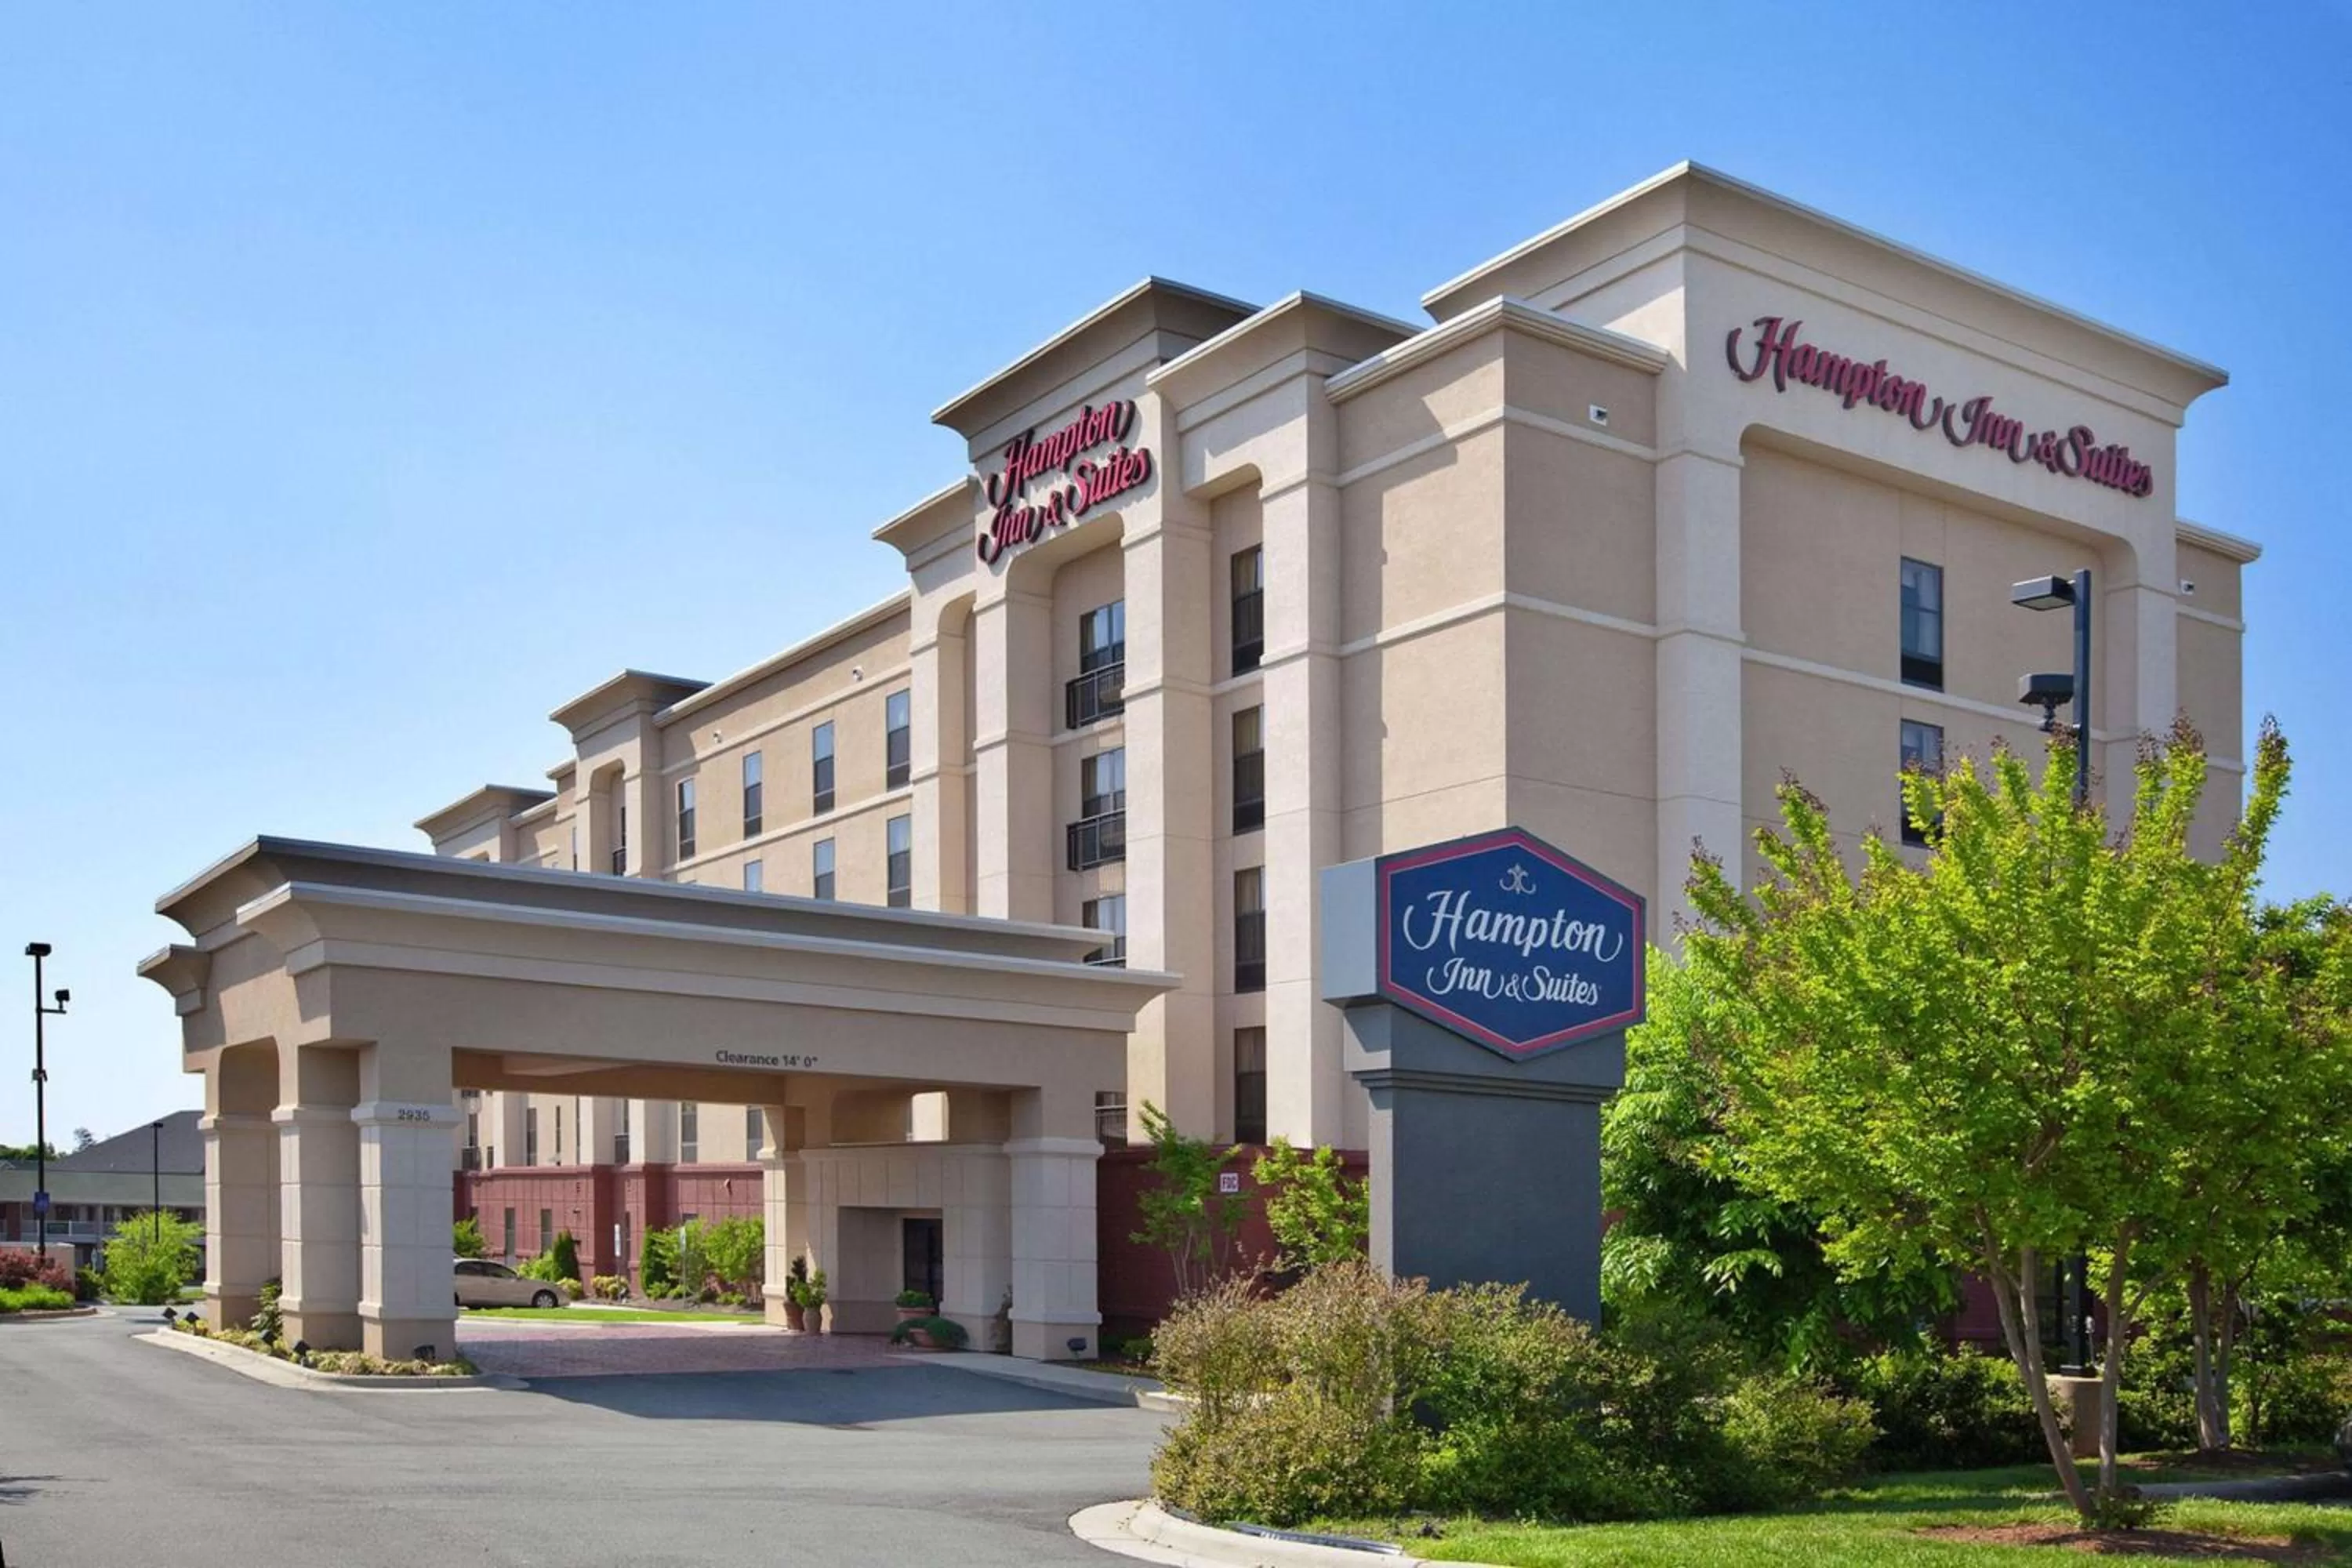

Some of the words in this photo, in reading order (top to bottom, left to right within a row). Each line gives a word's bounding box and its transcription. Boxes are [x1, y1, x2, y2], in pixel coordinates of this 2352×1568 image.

[1726, 316, 1943, 430] Hampton
[1943, 396, 2038, 463] Inn
[2056, 425, 2154, 498] Suites
[988, 400, 1137, 510] Hampton
[978, 503, 1046, 564] Inn
[1044, 490, 1067, 526] &
[1065, 445, 1152, 517] Suites
[1403, 890, 1624, 963] Hampton
[1426, 957, 1505, 1000] Inn
[1504, 974, 1525, 1003] &
[1522, 965, 1599, 1006] Suites
[715, 1050, 779, 1065] Clearance
[782, 1054, 800, 1067] 14'
